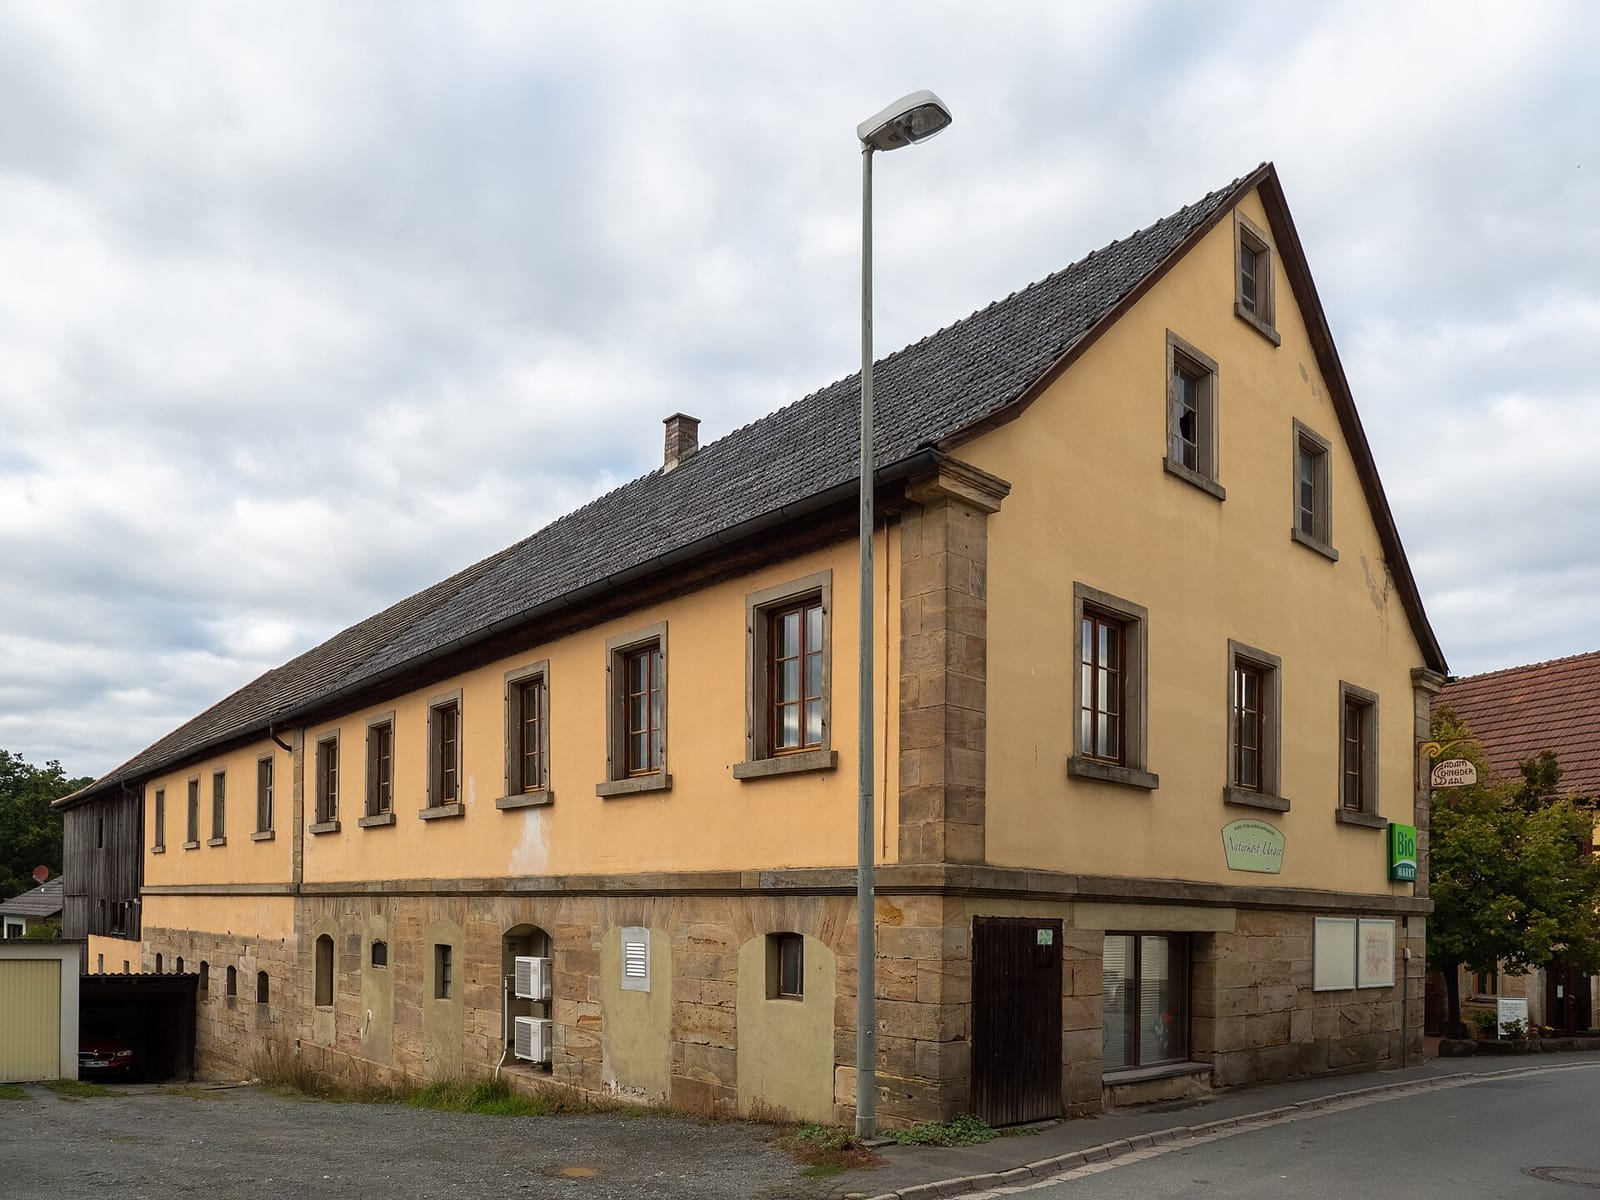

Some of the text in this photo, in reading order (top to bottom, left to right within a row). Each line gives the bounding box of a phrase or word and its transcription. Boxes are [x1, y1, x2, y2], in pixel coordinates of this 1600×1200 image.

[1444, 761, 1468, 769] ADAM
[1433, 777, 1465, 786] SAAL
[1398, 831, 1414, 857] Bio
[1398, 867, 1415, 878] MARKT
